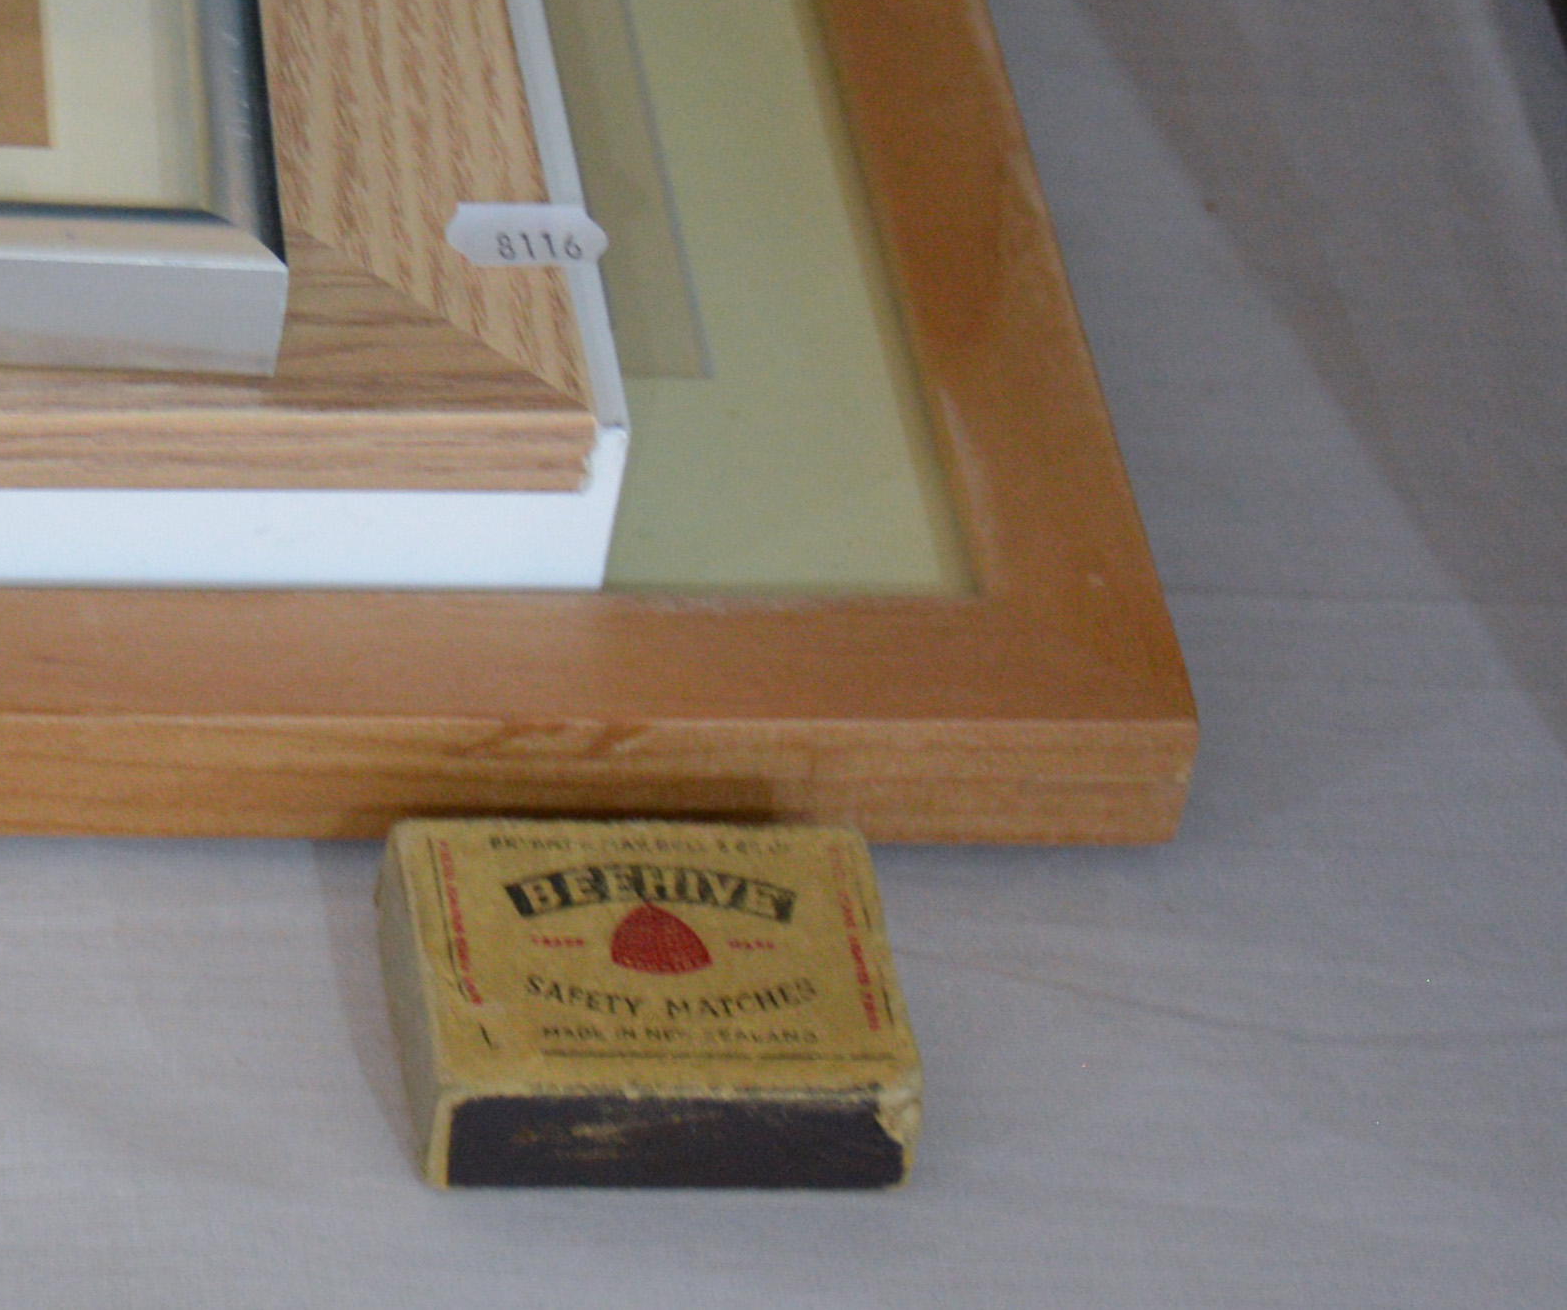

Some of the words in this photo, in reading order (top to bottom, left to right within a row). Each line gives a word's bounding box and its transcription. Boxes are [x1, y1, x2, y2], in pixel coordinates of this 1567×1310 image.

[495, 231, 583, 262] 8116
[517, 864, 779, 920] BEEHIVE
[525, 974, 643, 1018] SAFETY
[665, 977, 818, 1020] MATCHES
